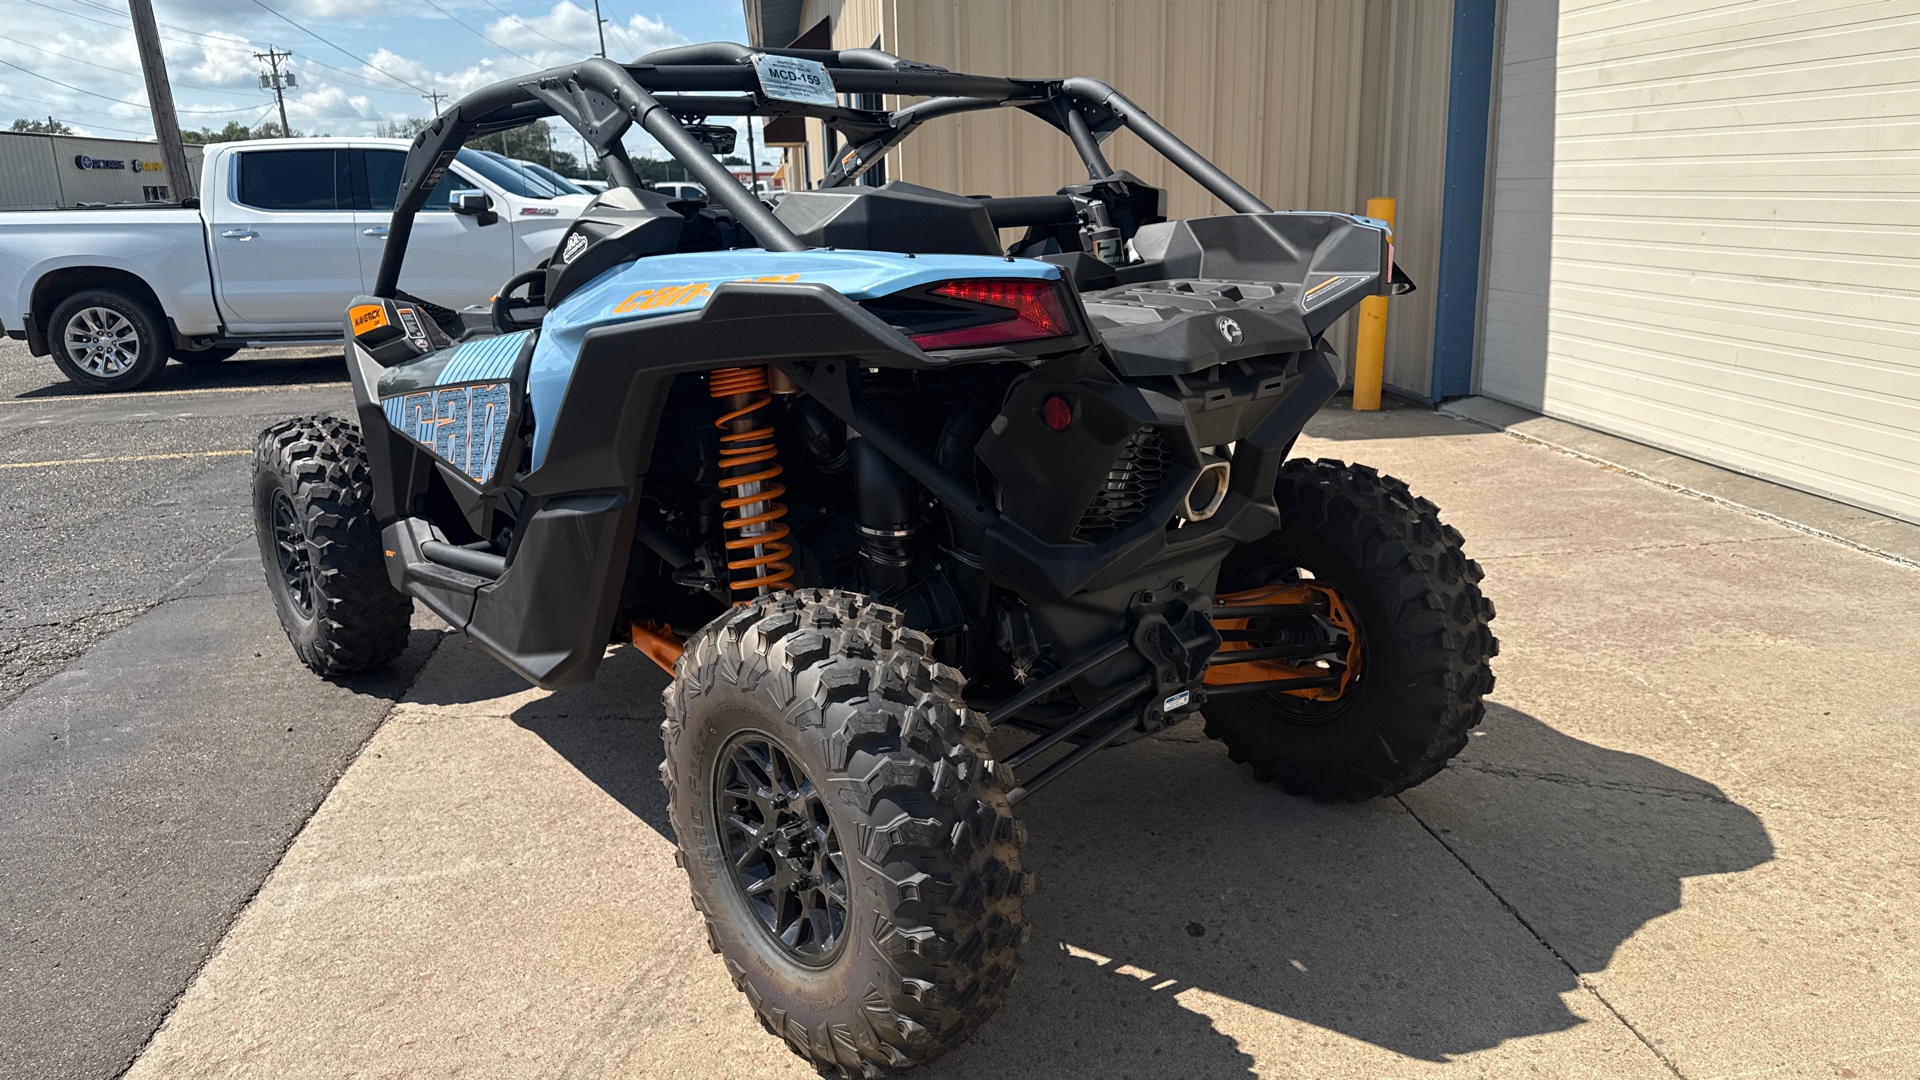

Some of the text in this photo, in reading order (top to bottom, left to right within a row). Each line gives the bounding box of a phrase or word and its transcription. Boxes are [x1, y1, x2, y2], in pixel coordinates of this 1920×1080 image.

[768, 68, 821, 86] MCD-159
[354, 308, 382, 327] MAVERICK
[690, 804, 718, 885] TRAC
